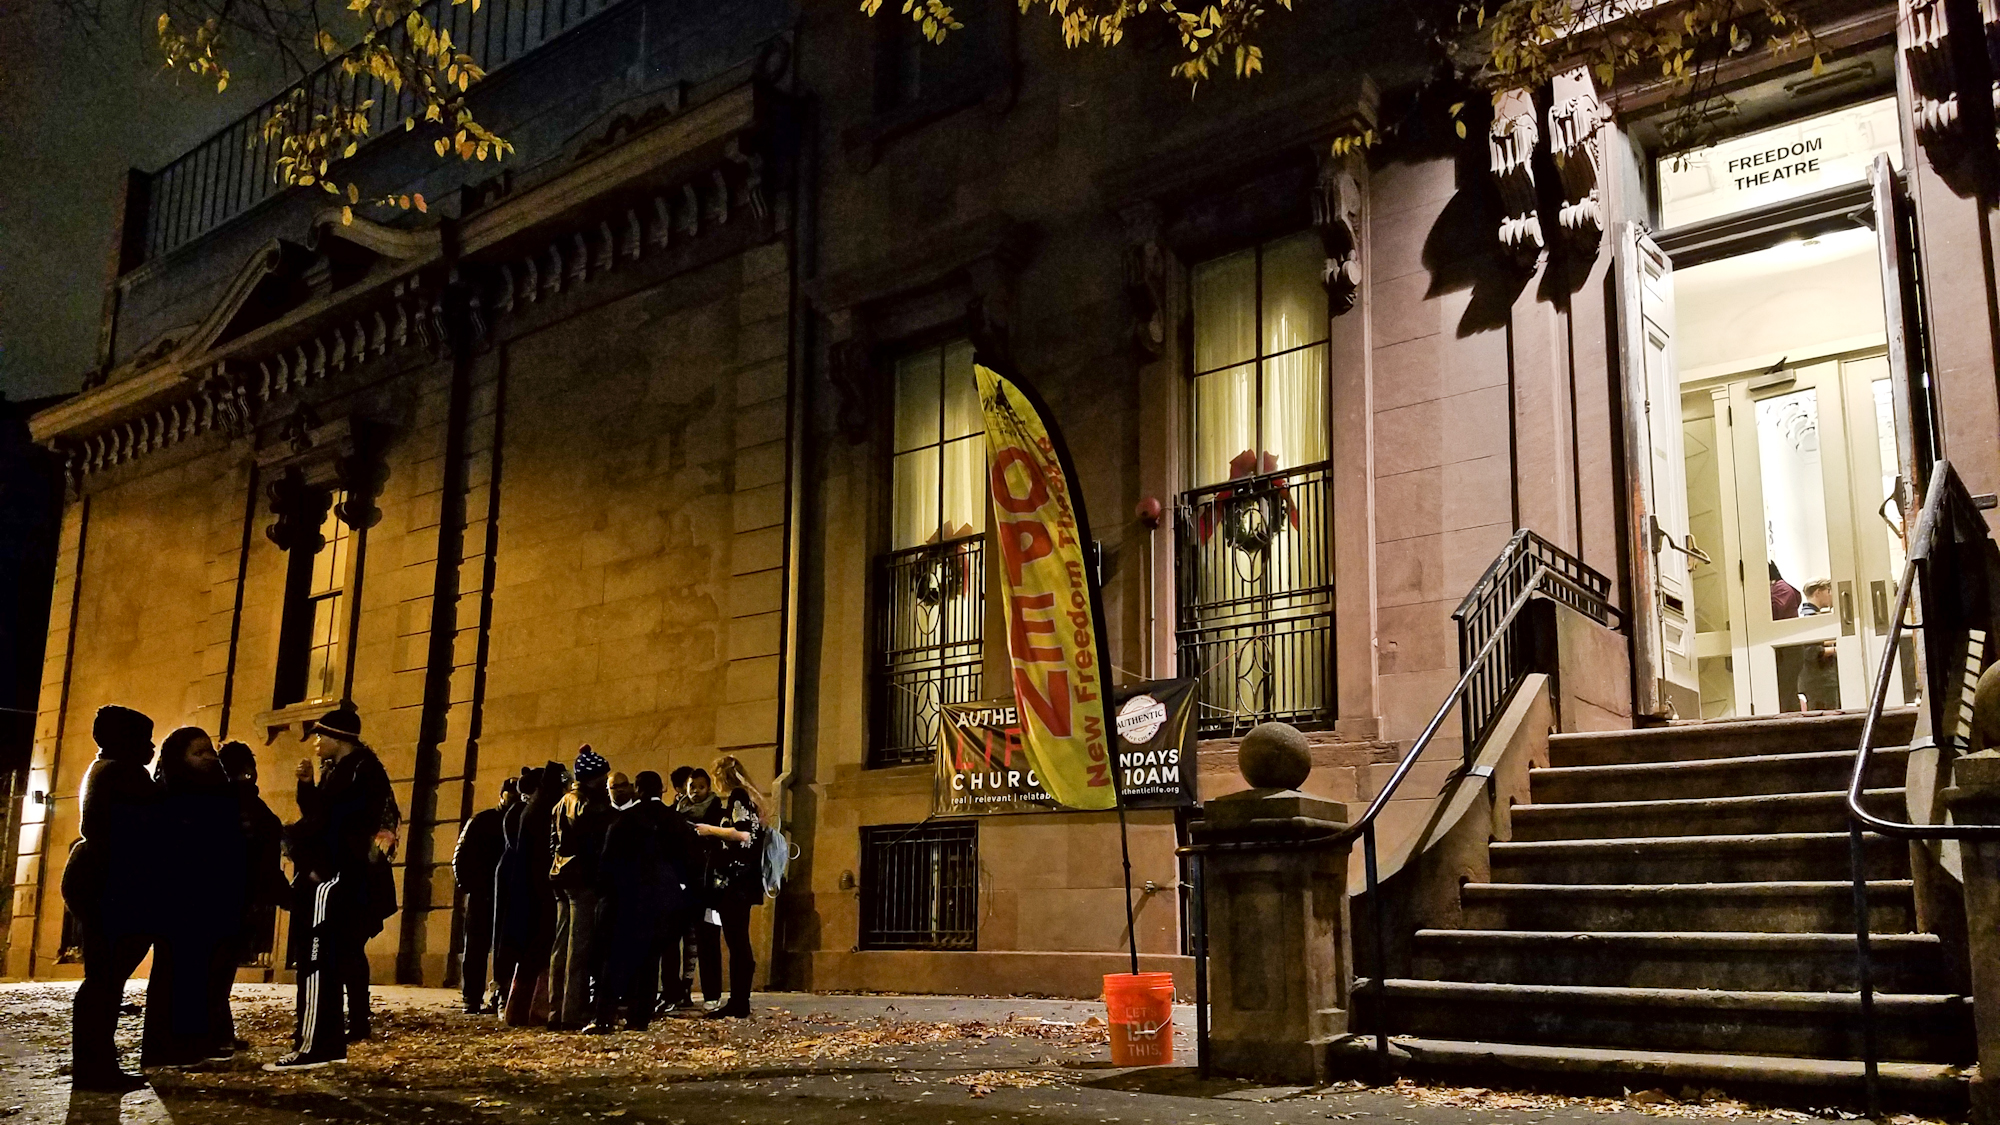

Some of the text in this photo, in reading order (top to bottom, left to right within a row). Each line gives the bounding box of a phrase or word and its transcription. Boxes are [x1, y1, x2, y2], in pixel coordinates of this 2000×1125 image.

[1728, 137, 1823, 173] FREEDOM
[1734, 158, 1821, 191] THEATRE
[991, 446, 1072, 737] OPEN
[1065, 560, 1098, 704] Freedom
[956, 707, 1021, 728] AUTHE
[1117, 708, 1164, 729] AUTHENTIC
[1085, 715, 1111, 788] New
[1124, 765, 1180, 786] 10AM
[951, 796, 967, 805] real
[975, 794, 1012, 804] relevant
[1019, 792, 1055, 801] relatab
[1125, 1006, 1158, 1018] LET'S
[1126, 1020, 1158, 1042] DO
